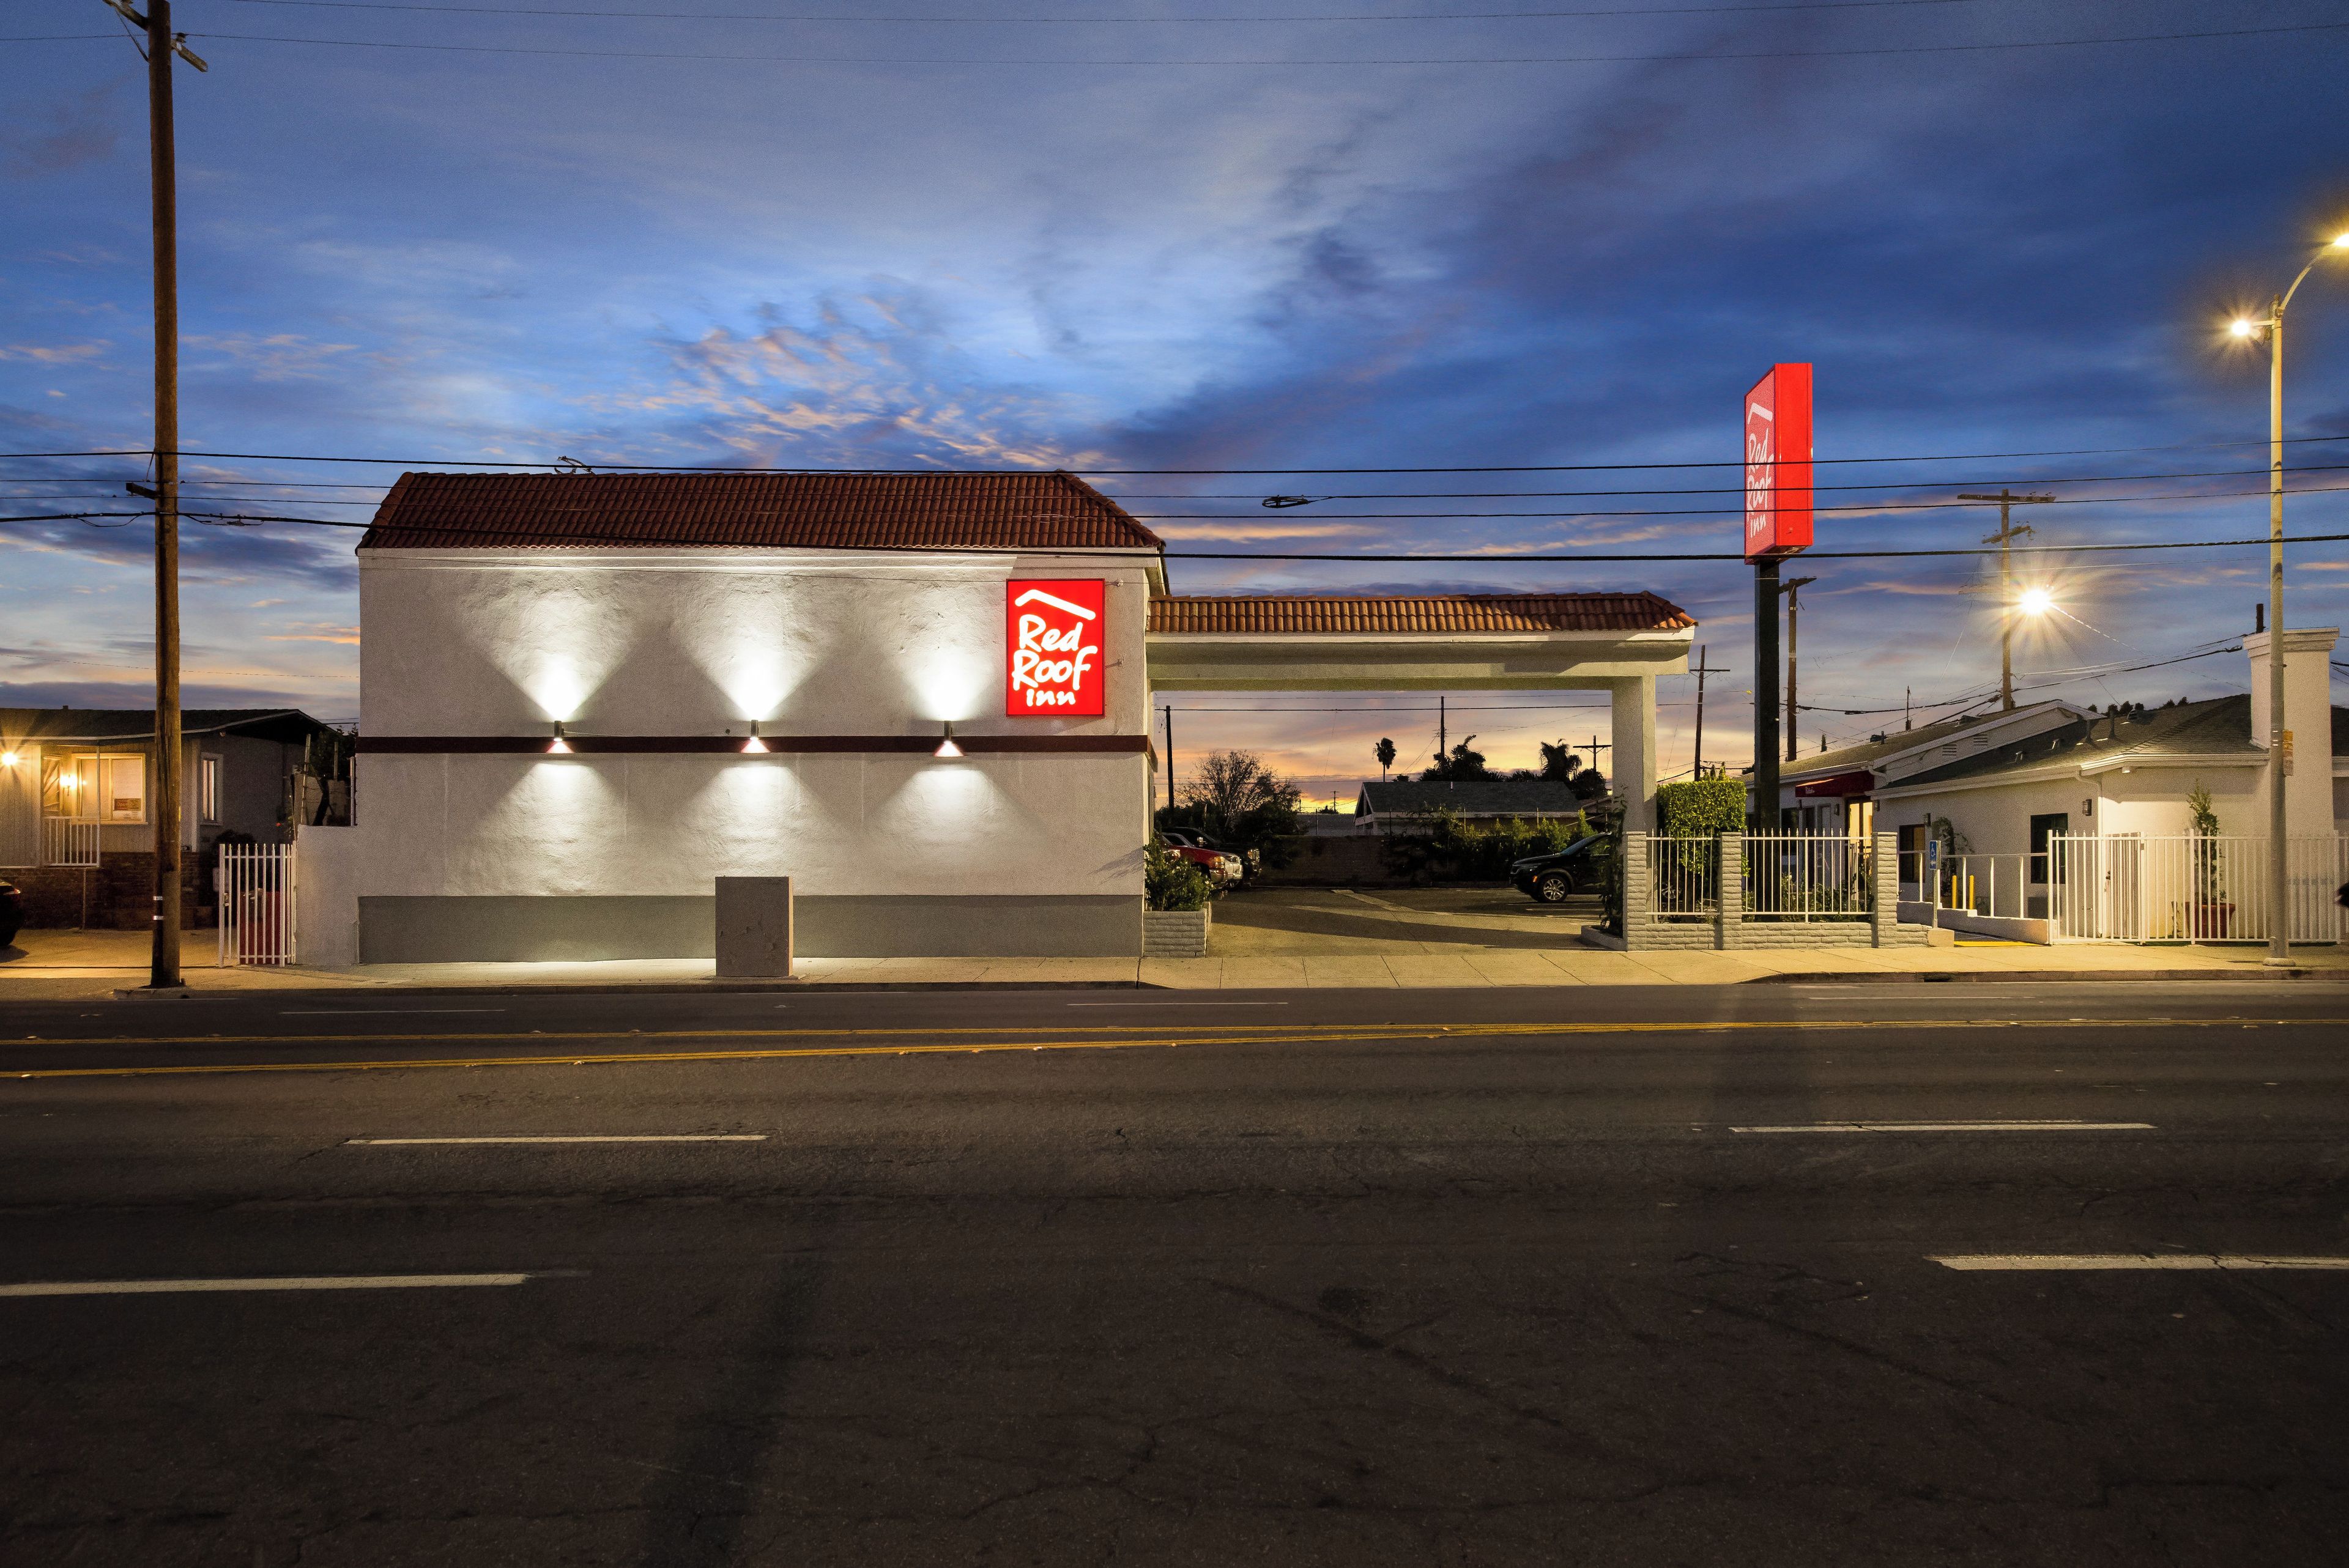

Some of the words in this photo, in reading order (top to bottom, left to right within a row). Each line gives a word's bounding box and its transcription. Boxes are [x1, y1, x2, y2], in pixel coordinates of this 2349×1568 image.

[1749, 428, 1768, 473] Red
[1746, 454, 1774, 523] Roof
[1019, 614, 1083, 652] Red
[1012, 646, 1097, 690] Roof
